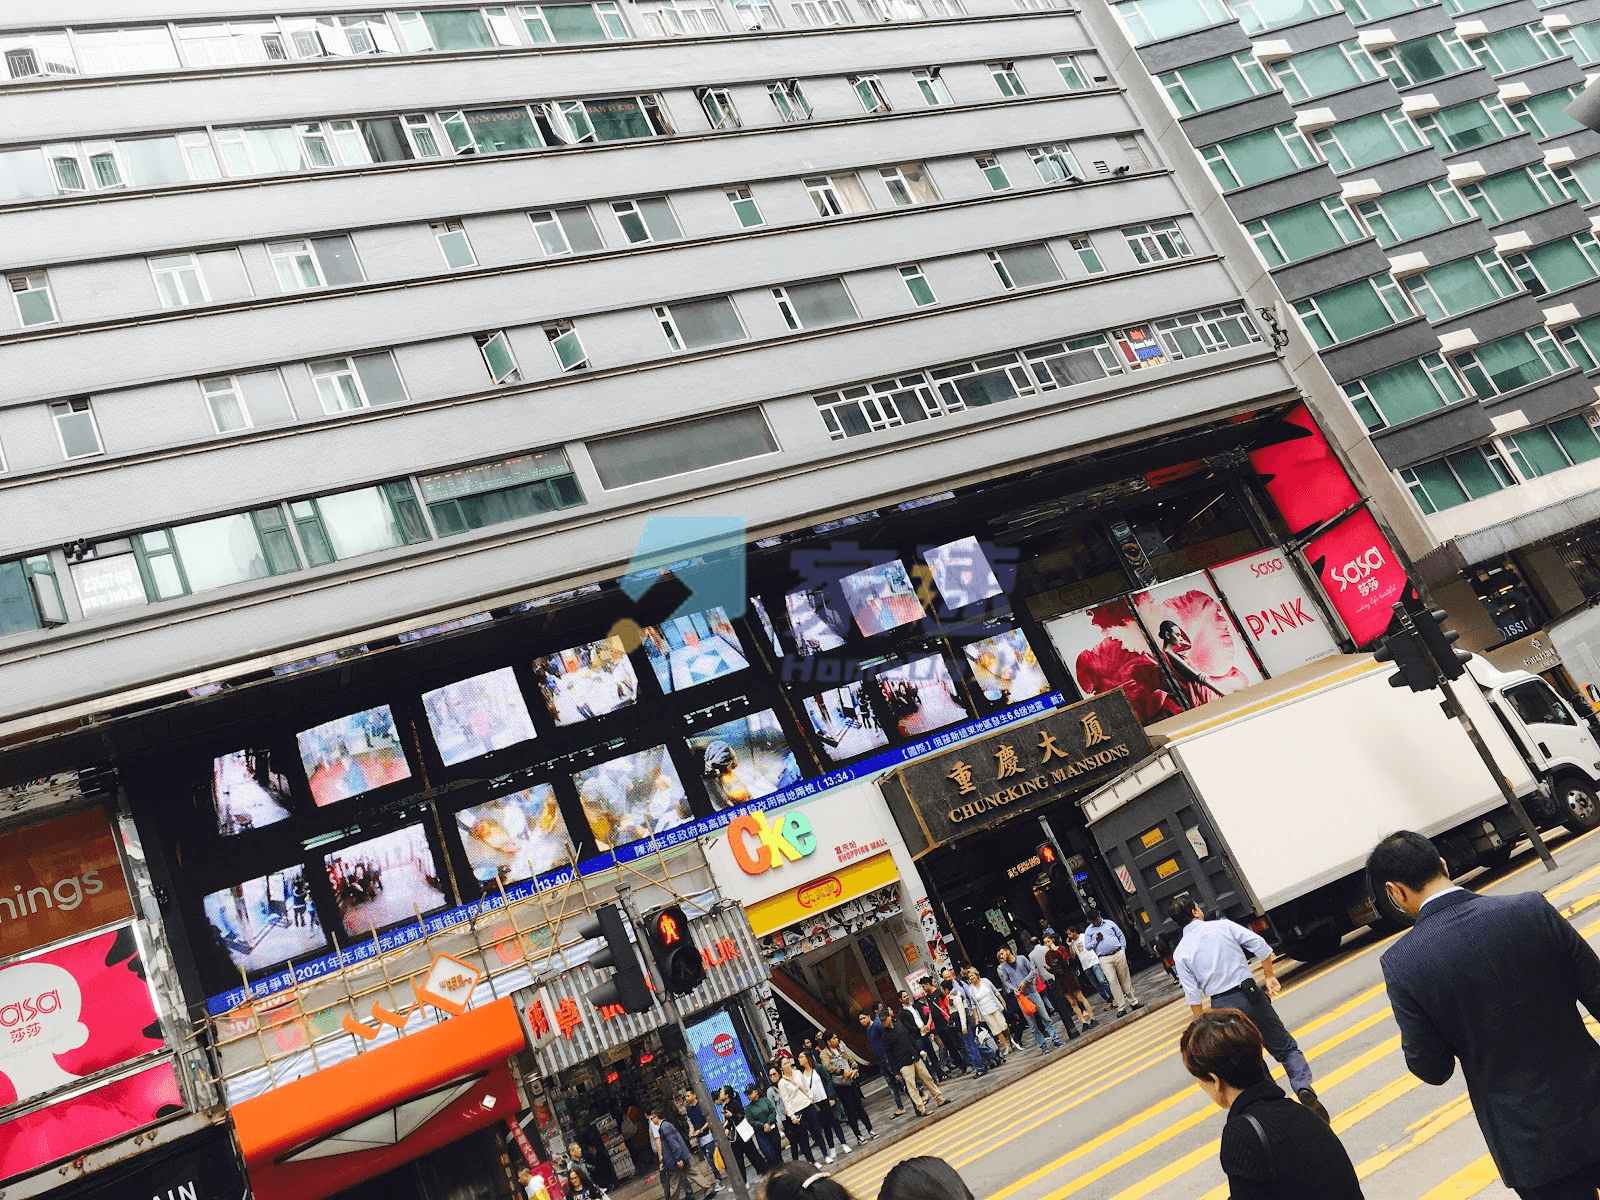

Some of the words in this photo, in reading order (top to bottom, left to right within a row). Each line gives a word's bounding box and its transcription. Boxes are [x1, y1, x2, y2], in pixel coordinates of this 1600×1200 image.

[947, 711, 1112, 796] 重慶大廈
[949, 776, 1049, 823] CHUNGKING
[1052, 743, 1130, 785] MANSIONS
[838, 845, 869, 863] SHOPPING
[869, 838, 888, 854] MALL
[10, 1022, 42, 1044] 莎莎
